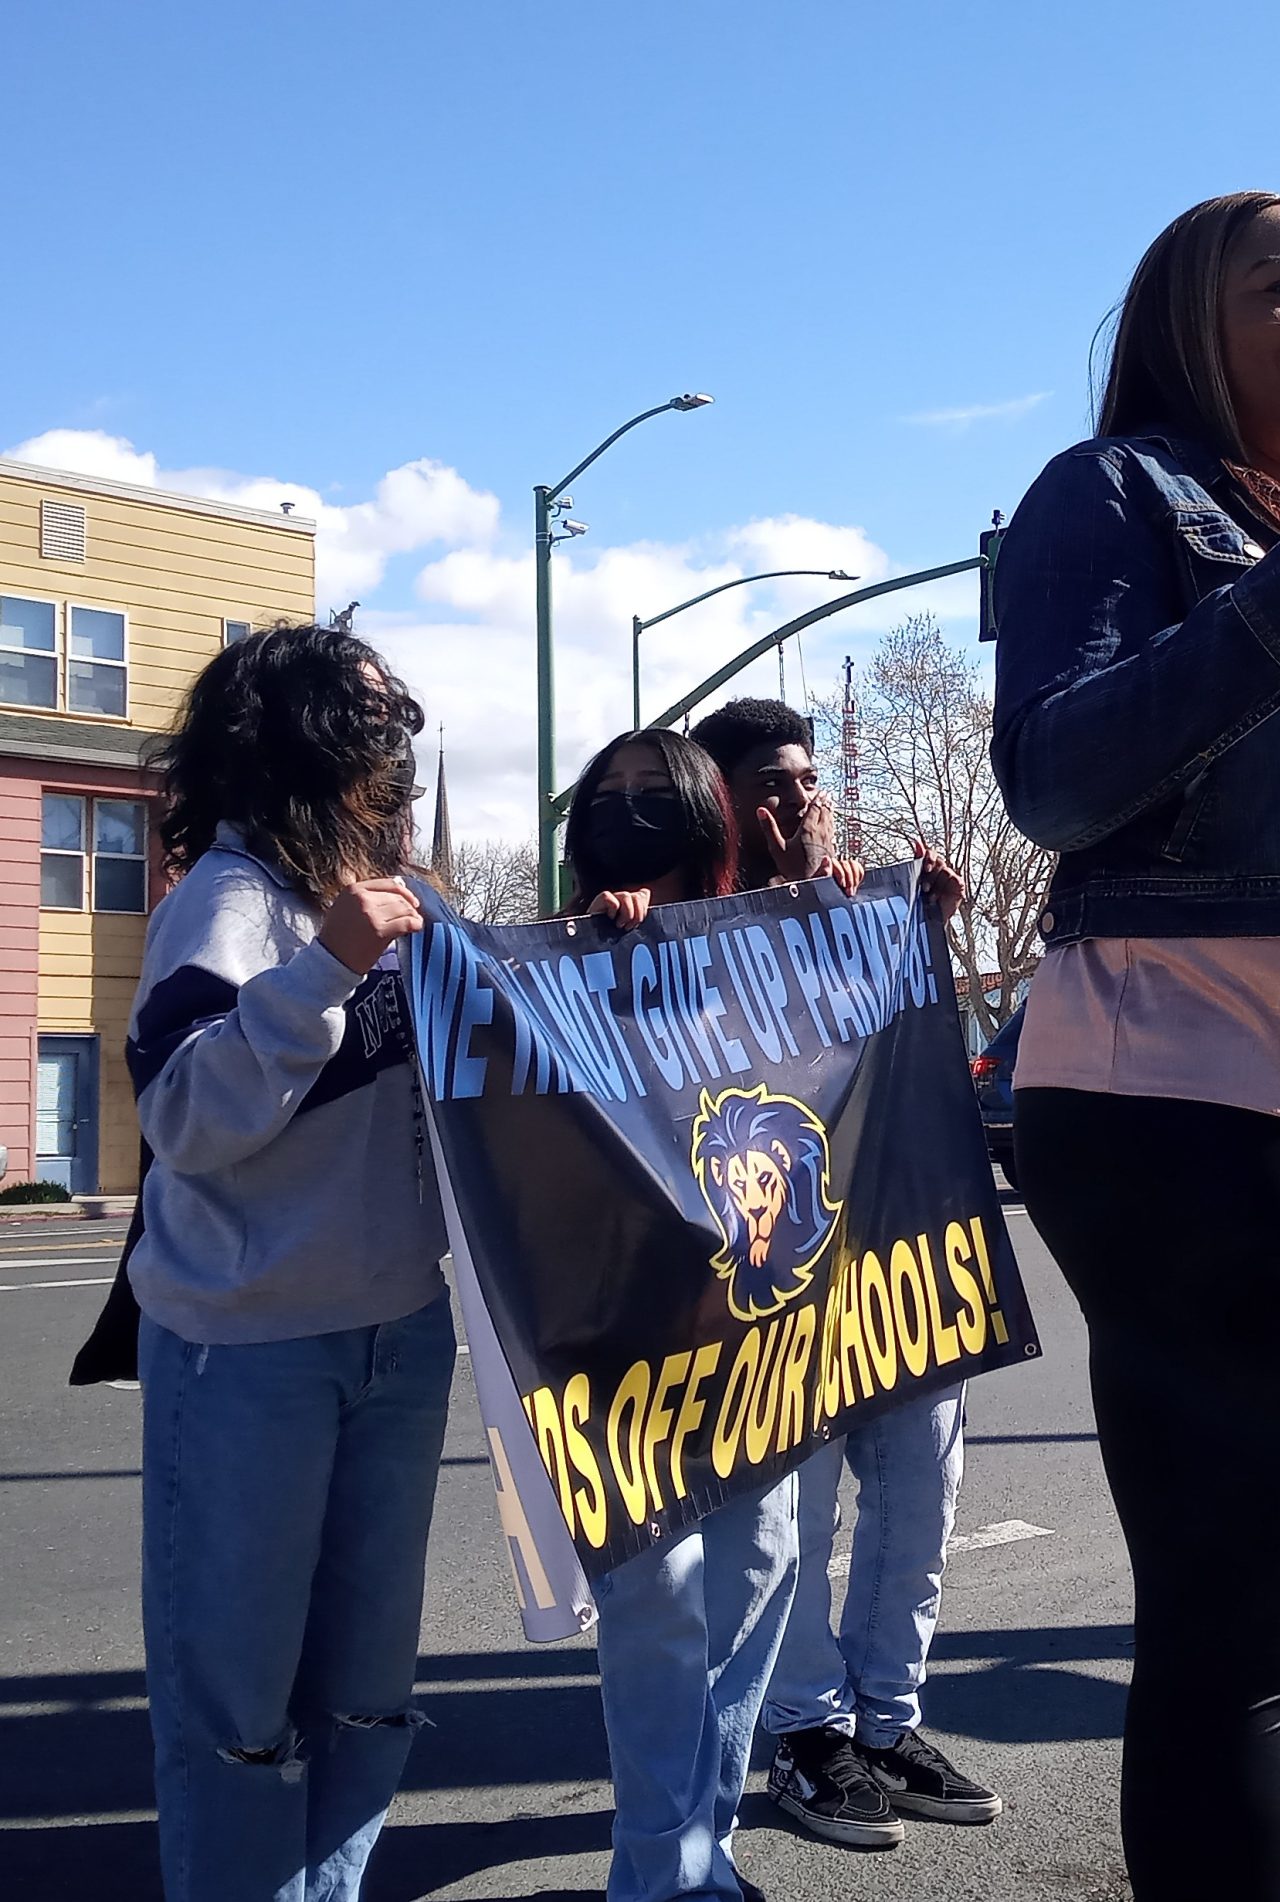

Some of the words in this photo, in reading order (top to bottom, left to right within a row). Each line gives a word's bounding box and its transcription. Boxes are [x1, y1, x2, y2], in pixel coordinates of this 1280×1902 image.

[411, 922, 493, 1101] WE
[631, 935, 750, 1091] GIVE
[719, 922, 801, 1066] UP
[606, 1340, 723, 1525] OFF
[711, 1302, 817, 1480] OUR
[813, 1215, 1009, 1429] SCHOOLS!
